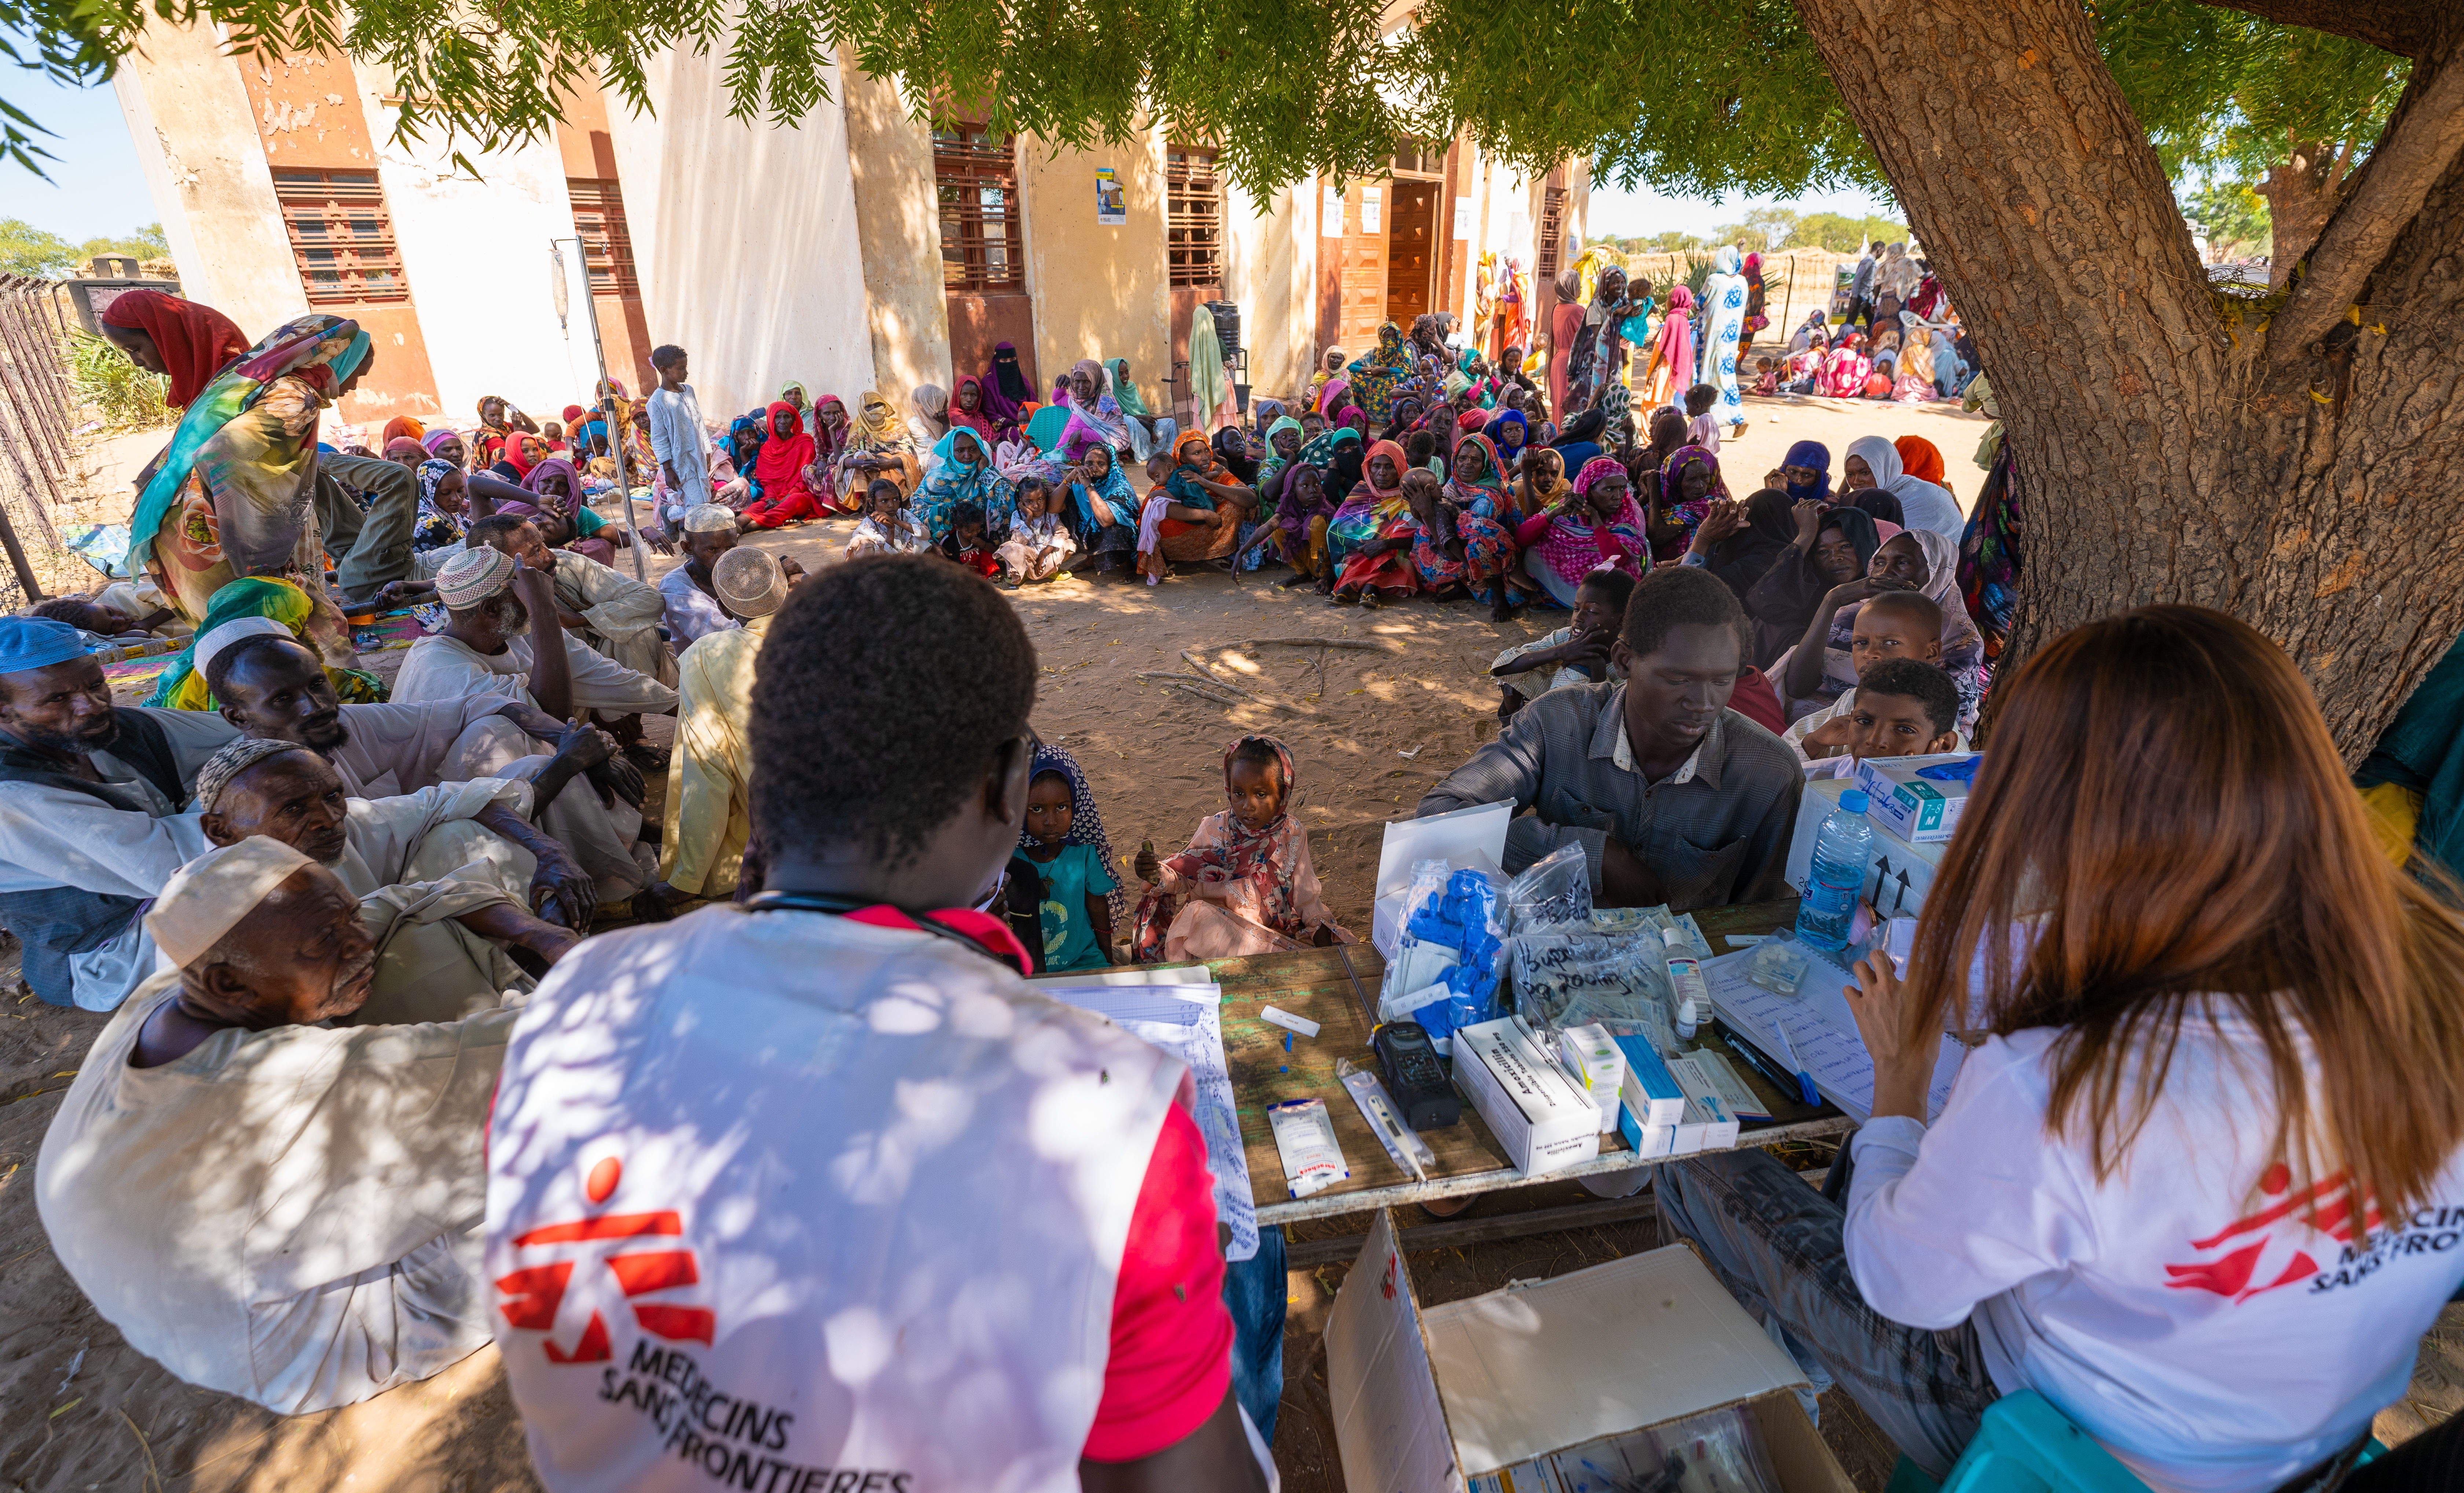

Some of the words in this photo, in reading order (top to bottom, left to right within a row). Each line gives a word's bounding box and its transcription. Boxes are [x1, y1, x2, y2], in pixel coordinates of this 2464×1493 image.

[1897, 791, 1908, 803] 7-8
[1908, 797, 1915, 807] M
[1924, 803, 1942, 815] 7-8
[1925, 815, 1936, 826] M
[1491, 1048, 1533, 1095] Amoxicillin
[1509, 1053, 1528, 1074] Tablets
[1527, 1074, 1556, 1107] Dispersible
[2390, 1232, 2460, 1261] FRO
[599, 1367, 677, 1433] SANS
[628, 1339, 794, 1452] MEDECINS
